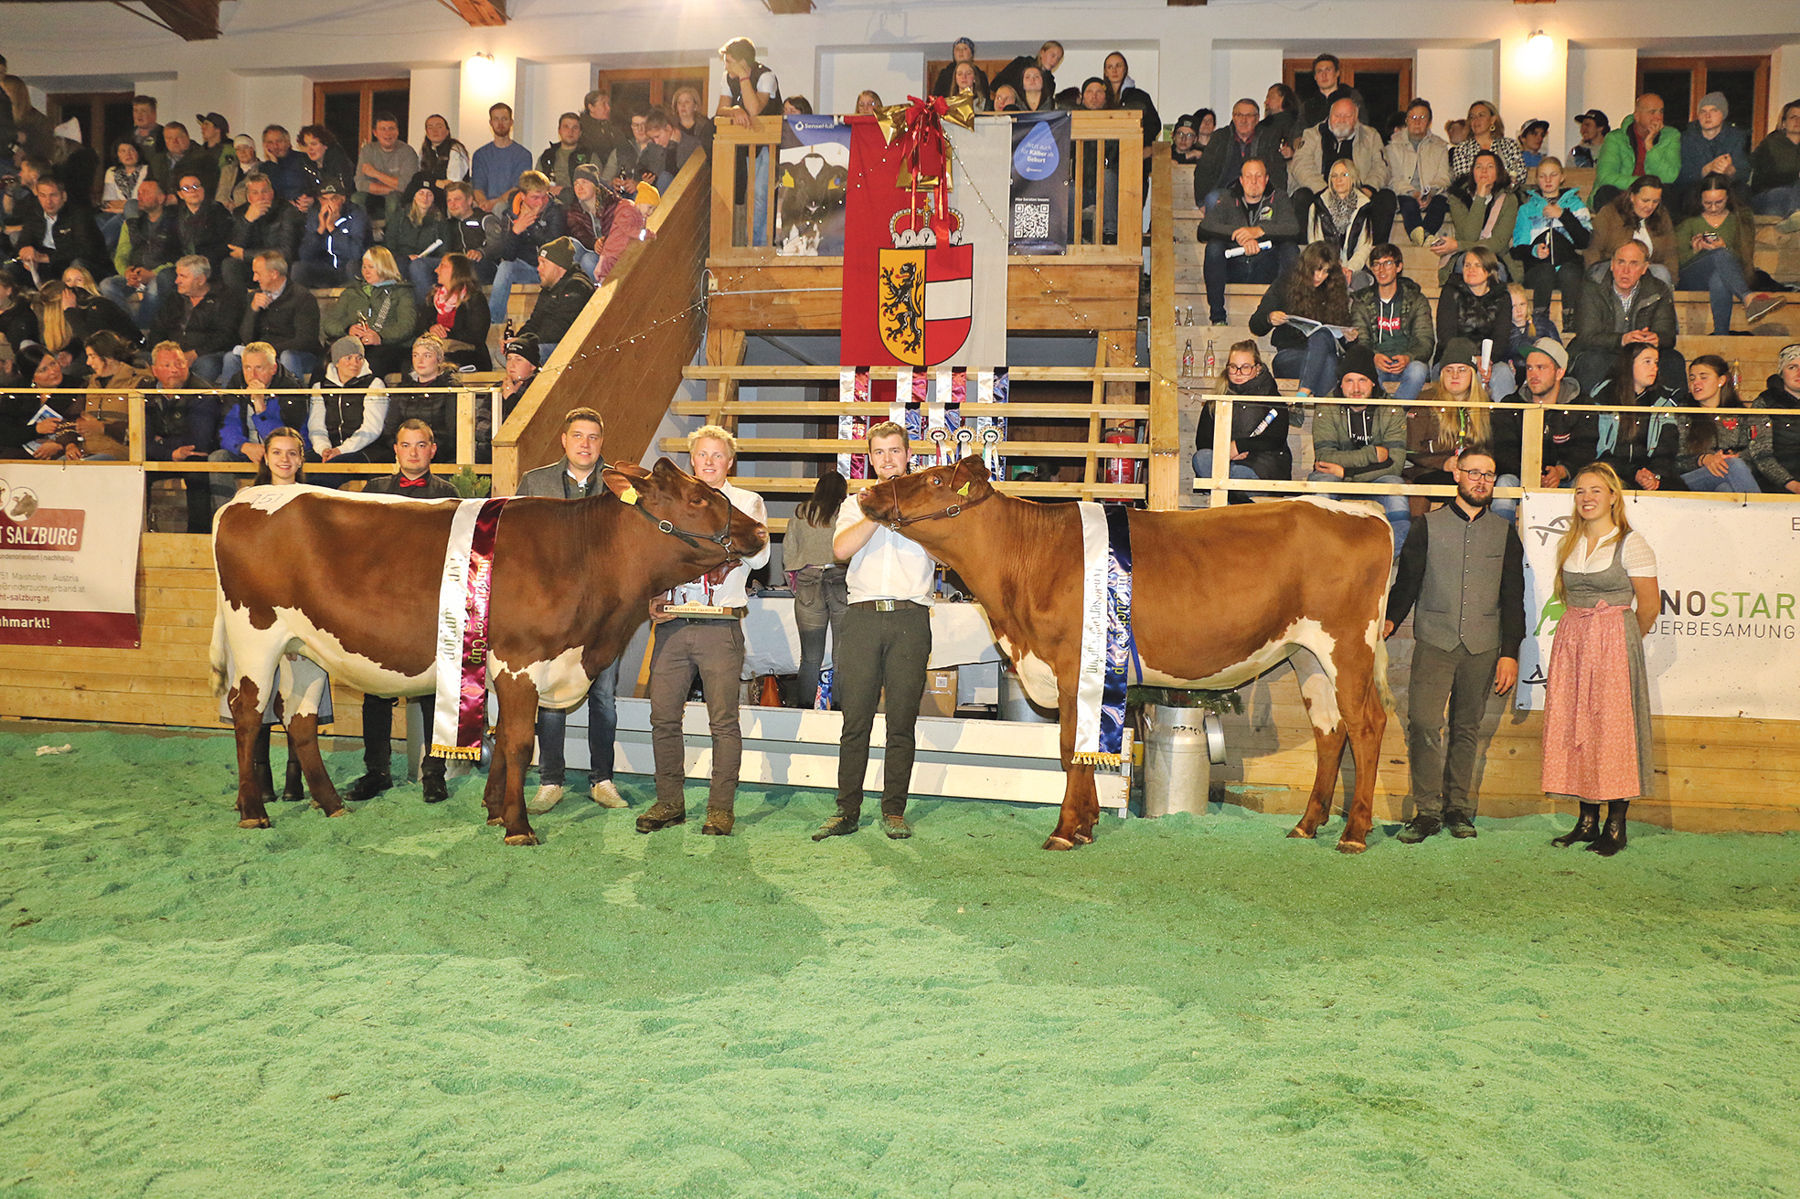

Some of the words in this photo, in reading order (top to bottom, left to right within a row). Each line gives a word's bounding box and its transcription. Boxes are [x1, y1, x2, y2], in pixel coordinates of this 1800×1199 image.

[6, 526, 78, 546] SALZBURG
[1660, 589, 1796, 620] NOSTAR
[468, 639, 488, 664] Cup
